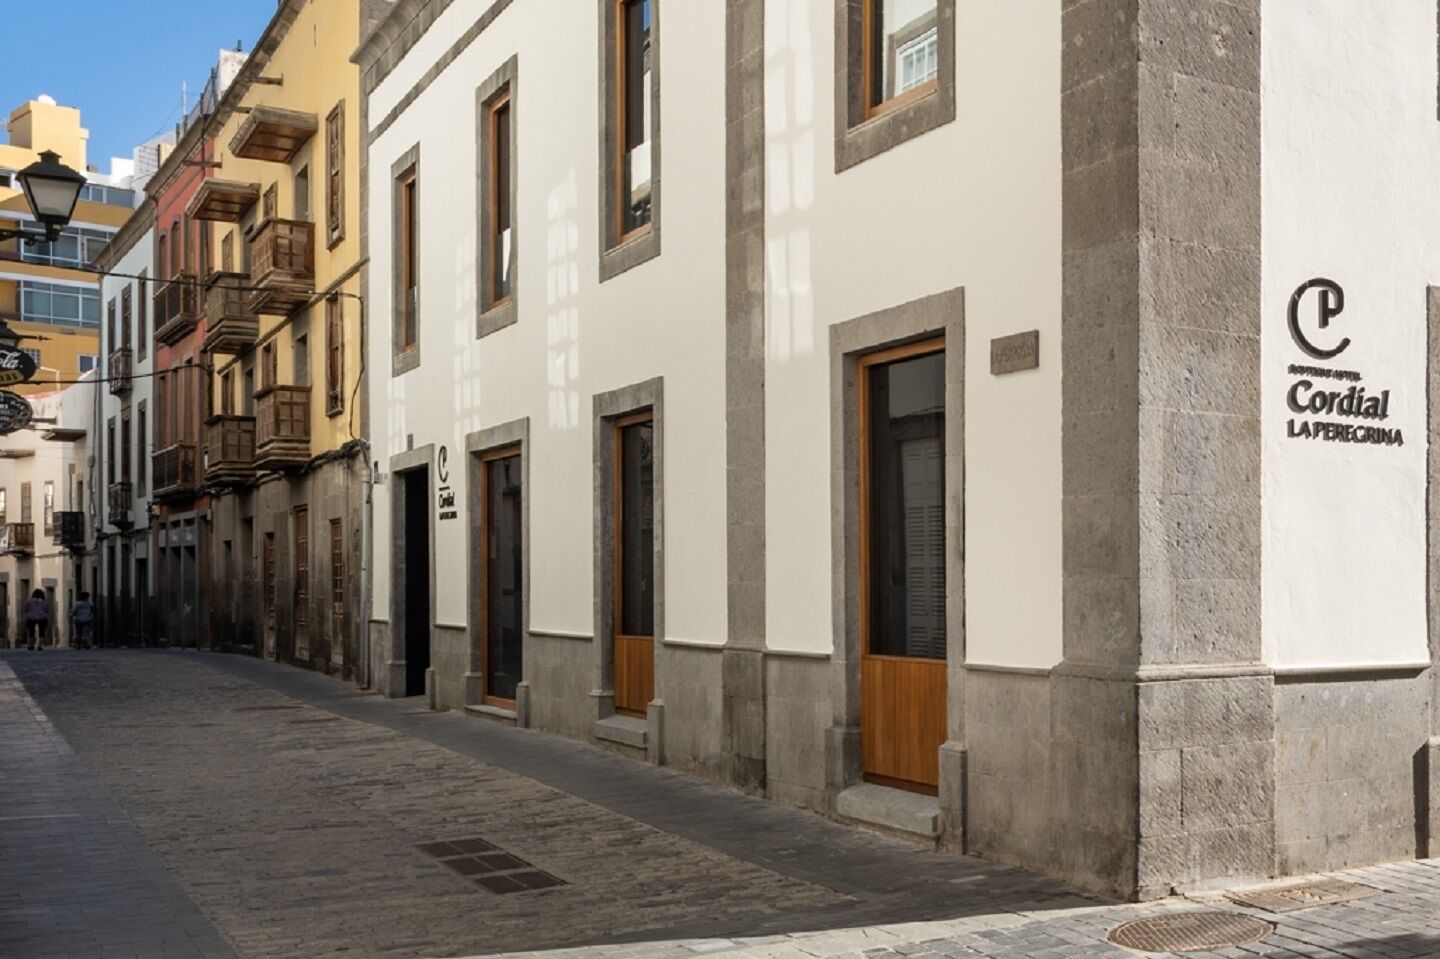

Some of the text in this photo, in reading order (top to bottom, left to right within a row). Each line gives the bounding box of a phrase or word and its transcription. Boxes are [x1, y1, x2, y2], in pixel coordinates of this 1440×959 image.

[1287, 380, 1389, 421] Cordial
[1287, 419, 1404, 447] LA PEREGRINA
